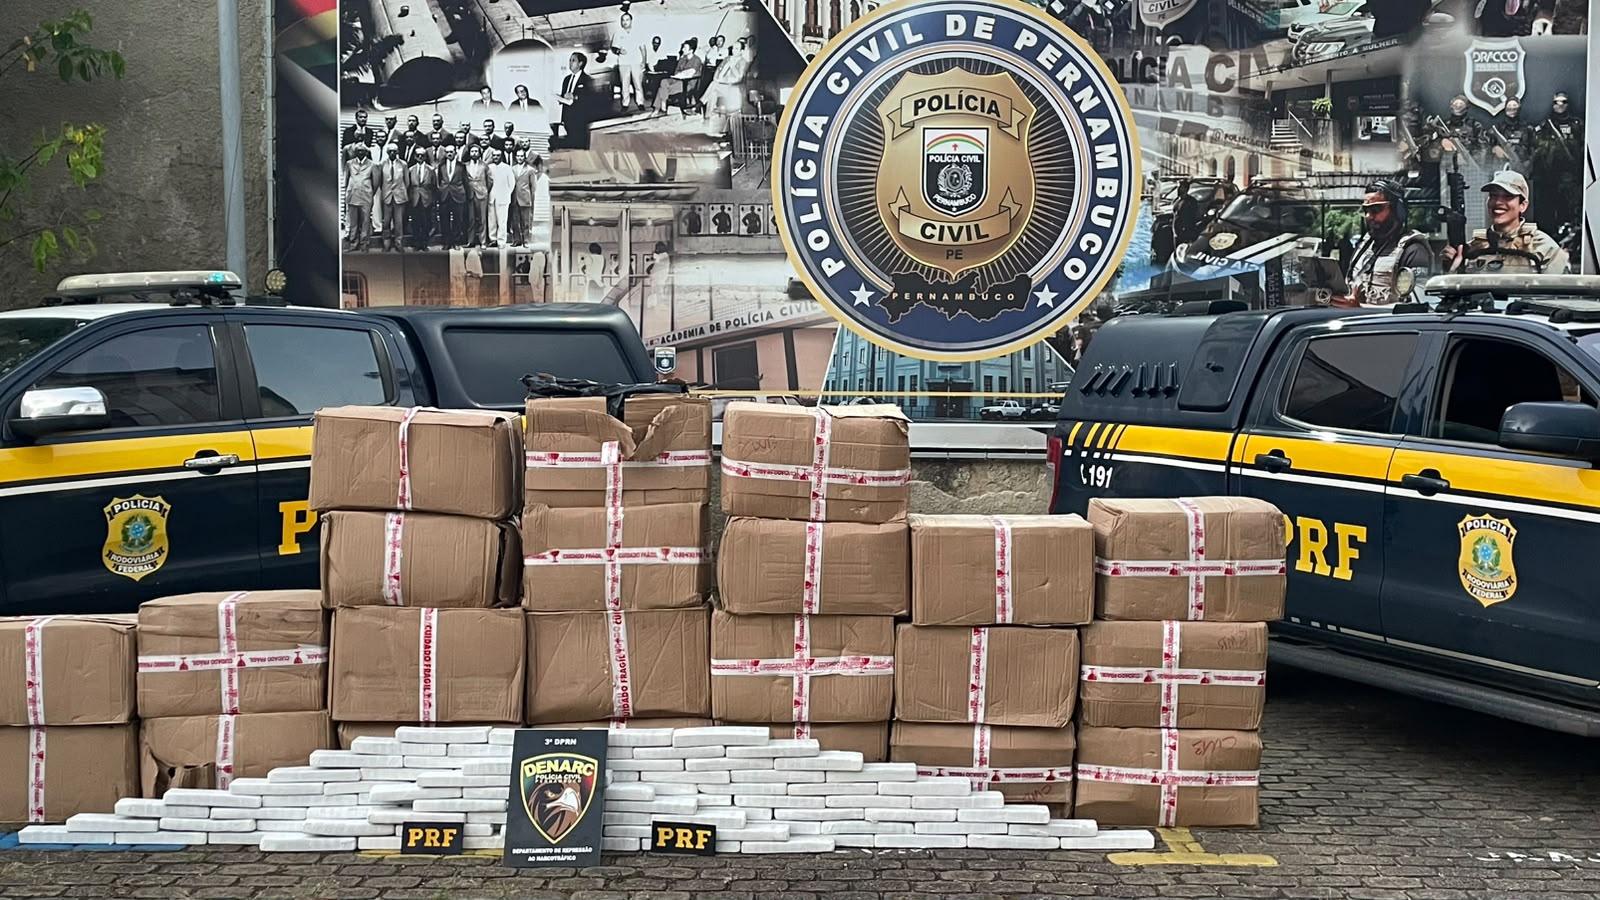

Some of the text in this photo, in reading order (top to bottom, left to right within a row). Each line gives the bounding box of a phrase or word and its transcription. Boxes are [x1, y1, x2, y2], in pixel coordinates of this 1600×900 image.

[1472, 51, 1518, 63] DRACCO
[912, 89, 1001, 118] POLÍCIA
[790, 14, 1119, 281] POLÍCIA CIVIL DE PERNAMBUCO
[928, 152, 981, 163] POLÍCIA CIVIL
[932, 193, 977, 207] PERNAMBUCO
[919, 222, 990, 243] CIVIL
[945, 249, 964, 260] PE
[892, 292, 1015, 301] PERNAMBUCO
[660, 301, 819, 345] ACADEMIA DE POLÍCIA CIVIL
[1088, 464, 1113, 488] 191
[117, 563, 155, 573] FEDERAL
[1471, 587, 1504, 599] FEDERAL
[423, 625, 432, 662] CUIDADO
[554, 738, 577, 746] DPRN
[524, 759, 595, 778] DENARC
[407, 828, 457, 847] PRF
[656, 826, 713, 850] PRF
[562, 845, 593, 854] REPRESSÃO
[536, 854, 577, 862] NARCOTRÁFICO
